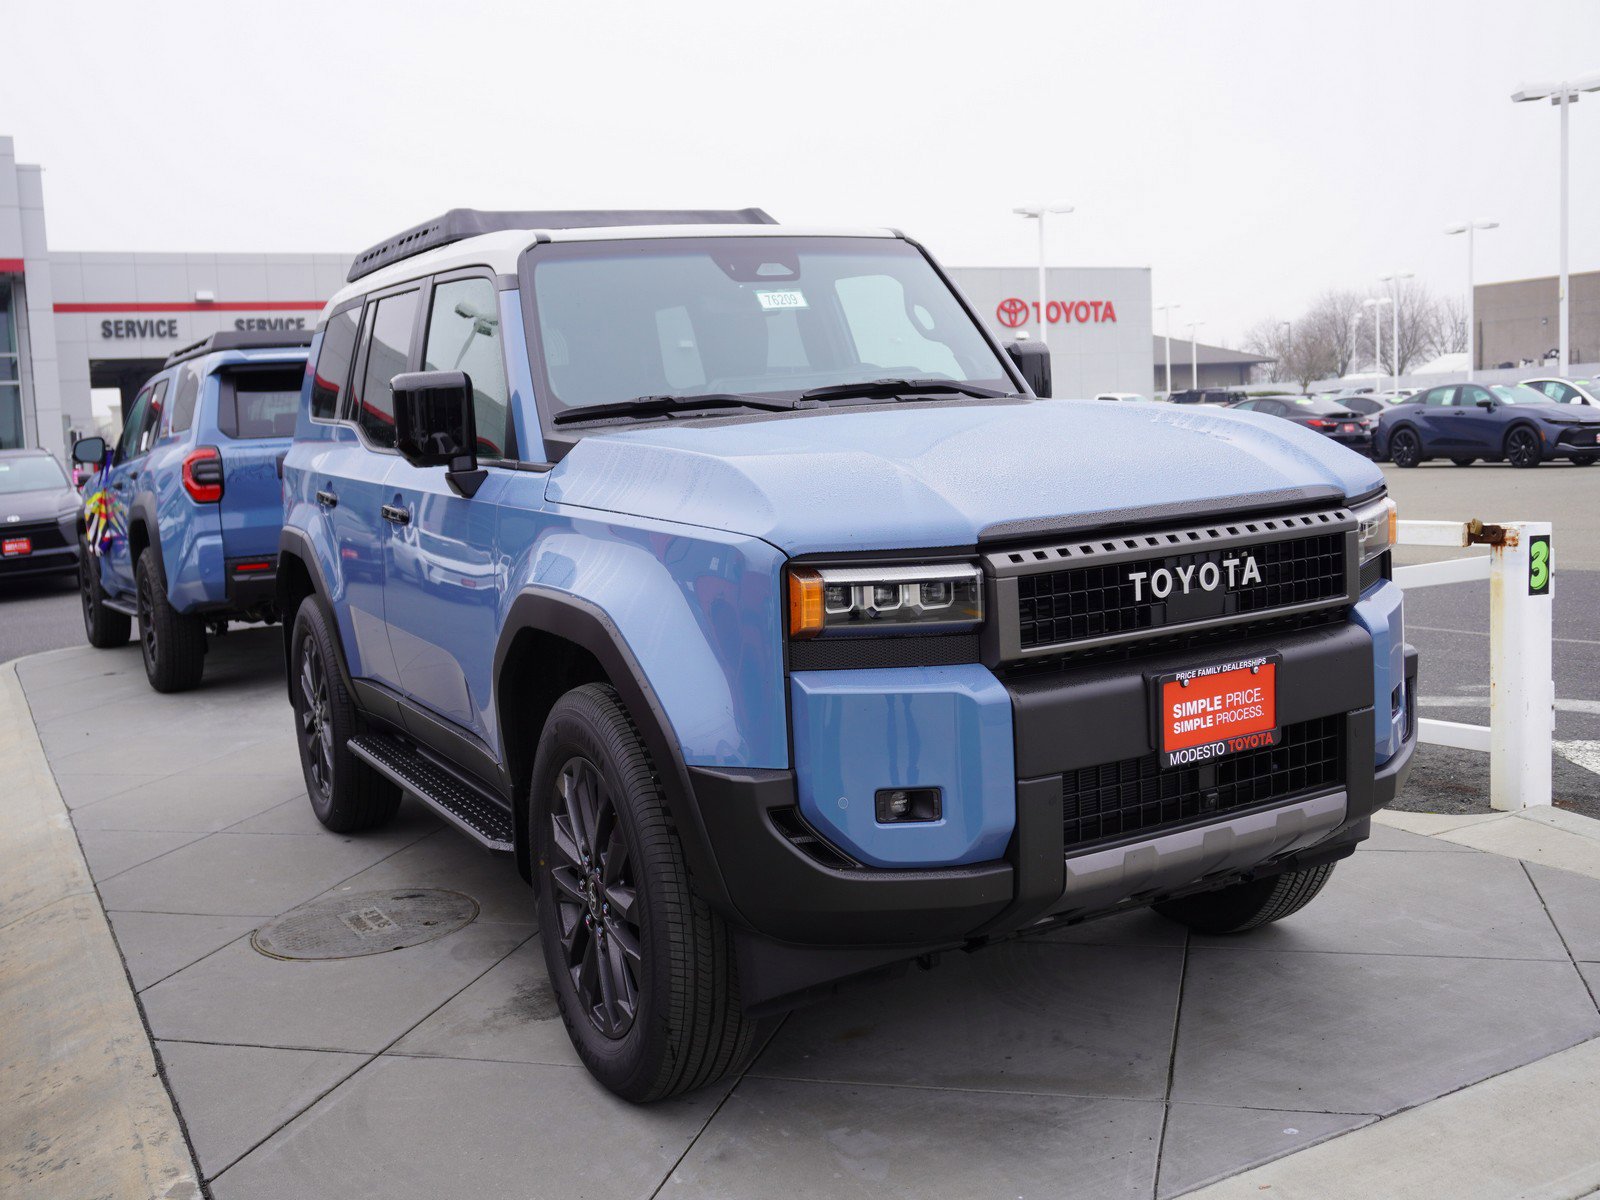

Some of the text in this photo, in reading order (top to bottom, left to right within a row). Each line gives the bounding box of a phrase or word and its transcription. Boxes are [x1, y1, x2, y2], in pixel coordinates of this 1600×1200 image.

[764, 294, 798, 306] 76209
[1032, 301, 1116, 324] TOYOTA
[101, 319, 178, 339] SERVICE
[1129, 556, 1262, 602] TOYOTA
[1531, 541, 1549, 590] 3
[1176, 657, 1267, 681] PRICE FAMILY DEALERSHIPS
[1173, 688, 1264, 719] SIMPLE PRICE.
[1173, 704, 1264, 735] SIMPLE PROCESS.
[1169, 732, 1274, 767] MODESTO TOYOTA
